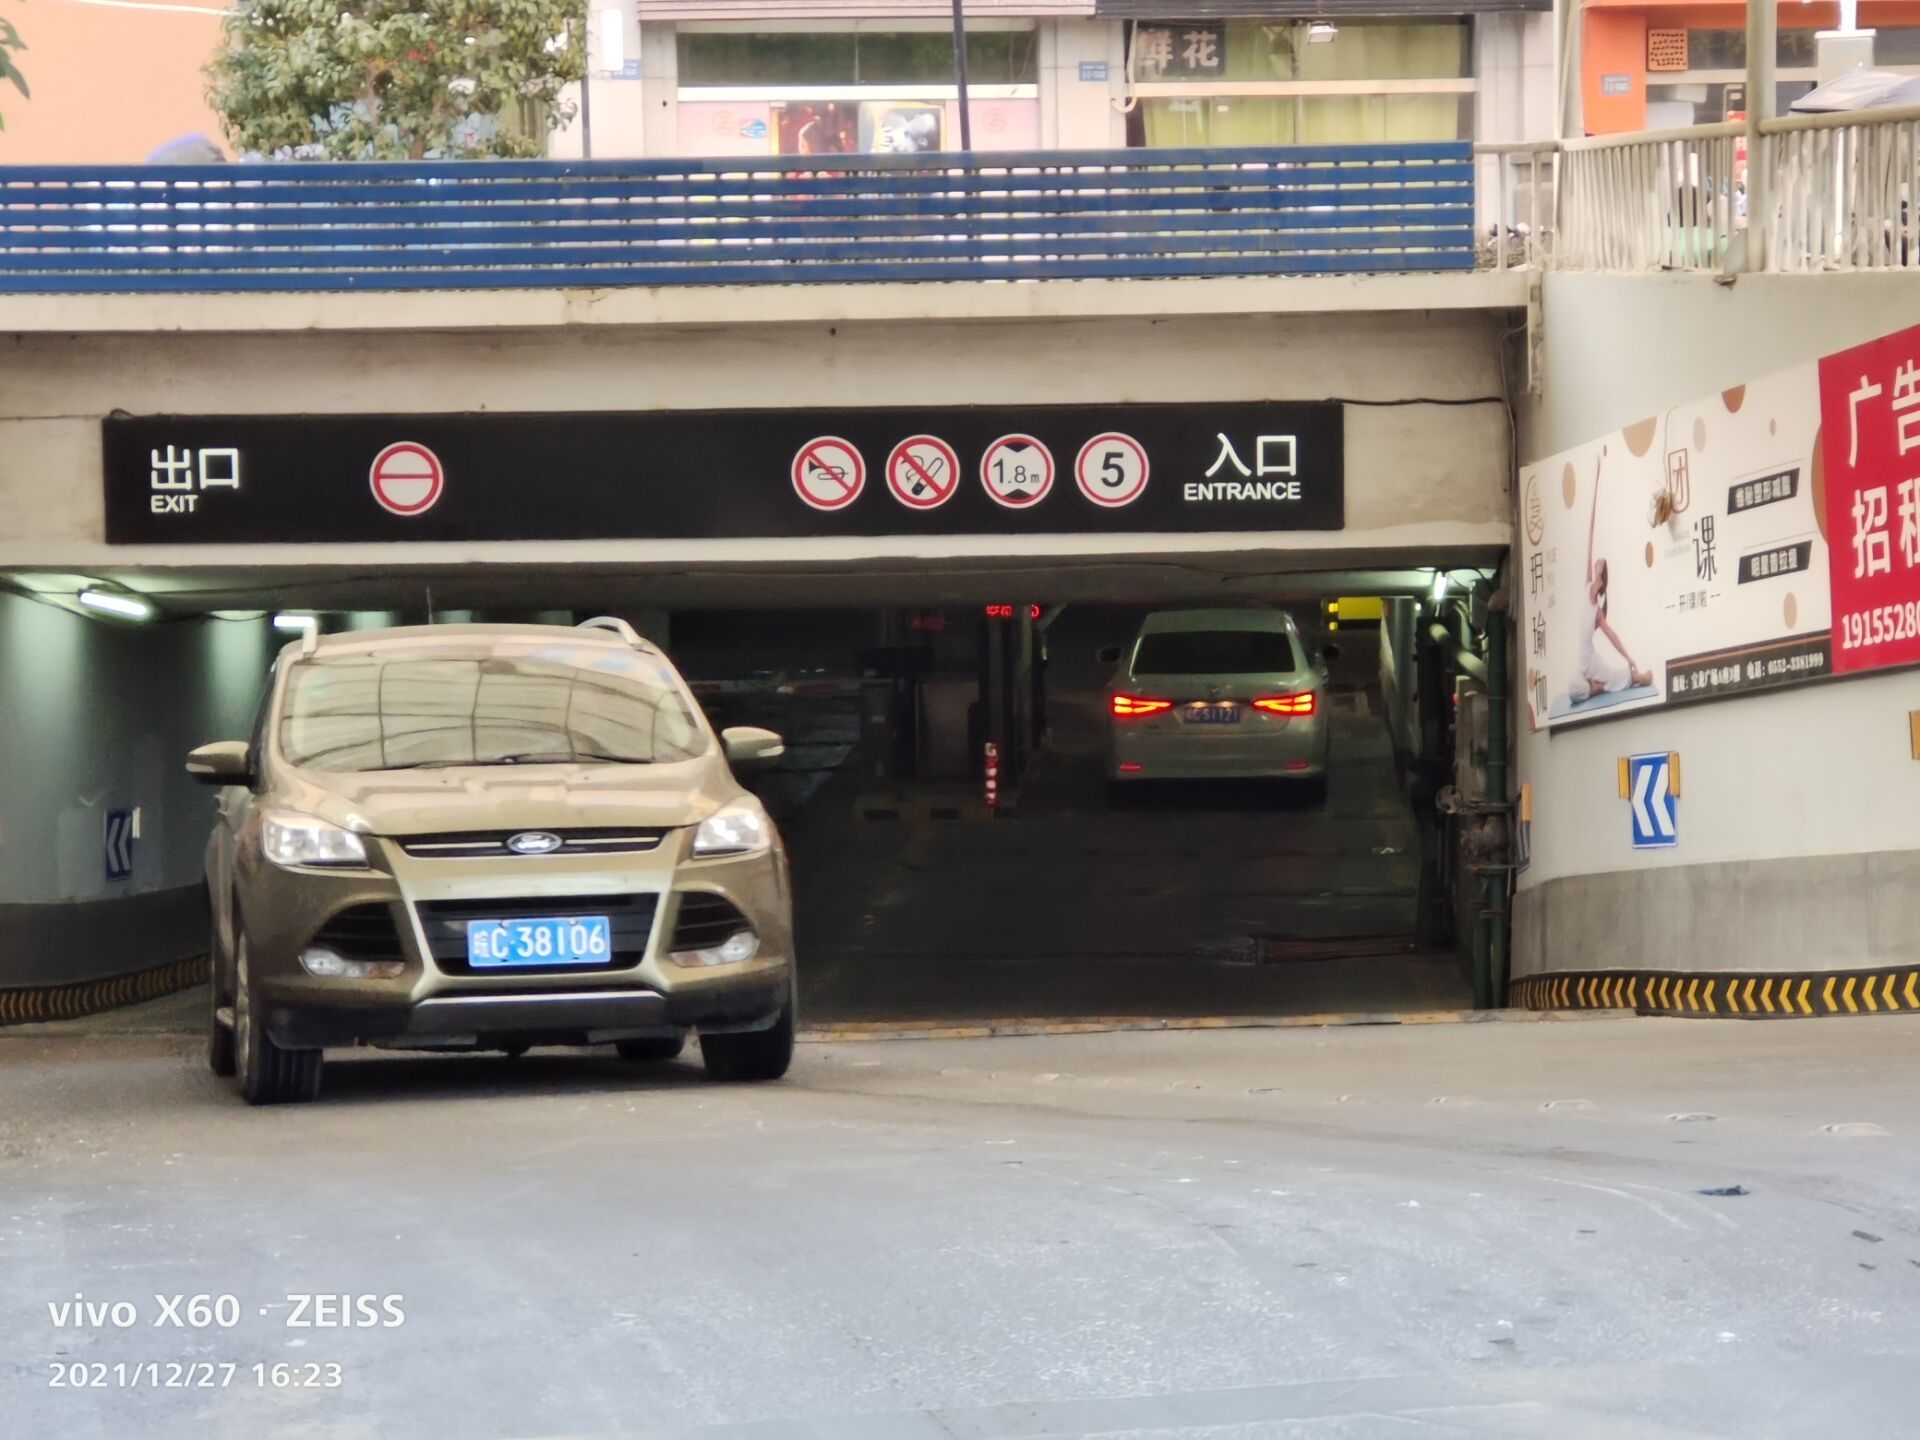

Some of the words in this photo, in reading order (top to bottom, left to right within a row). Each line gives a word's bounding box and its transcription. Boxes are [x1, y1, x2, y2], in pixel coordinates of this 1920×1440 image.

[1848, 359, 1920, 468] 广告
[150, 445, 240, 490] 出口
[1101, 452, 1125, 488] 5
[1205, 433, 1297, 477] 入口
[150, 494, 199, 513] EXIT
[1184, 482, 1302, 501] ENTRANCE
[1852, 476, 1920, 579] 招租
